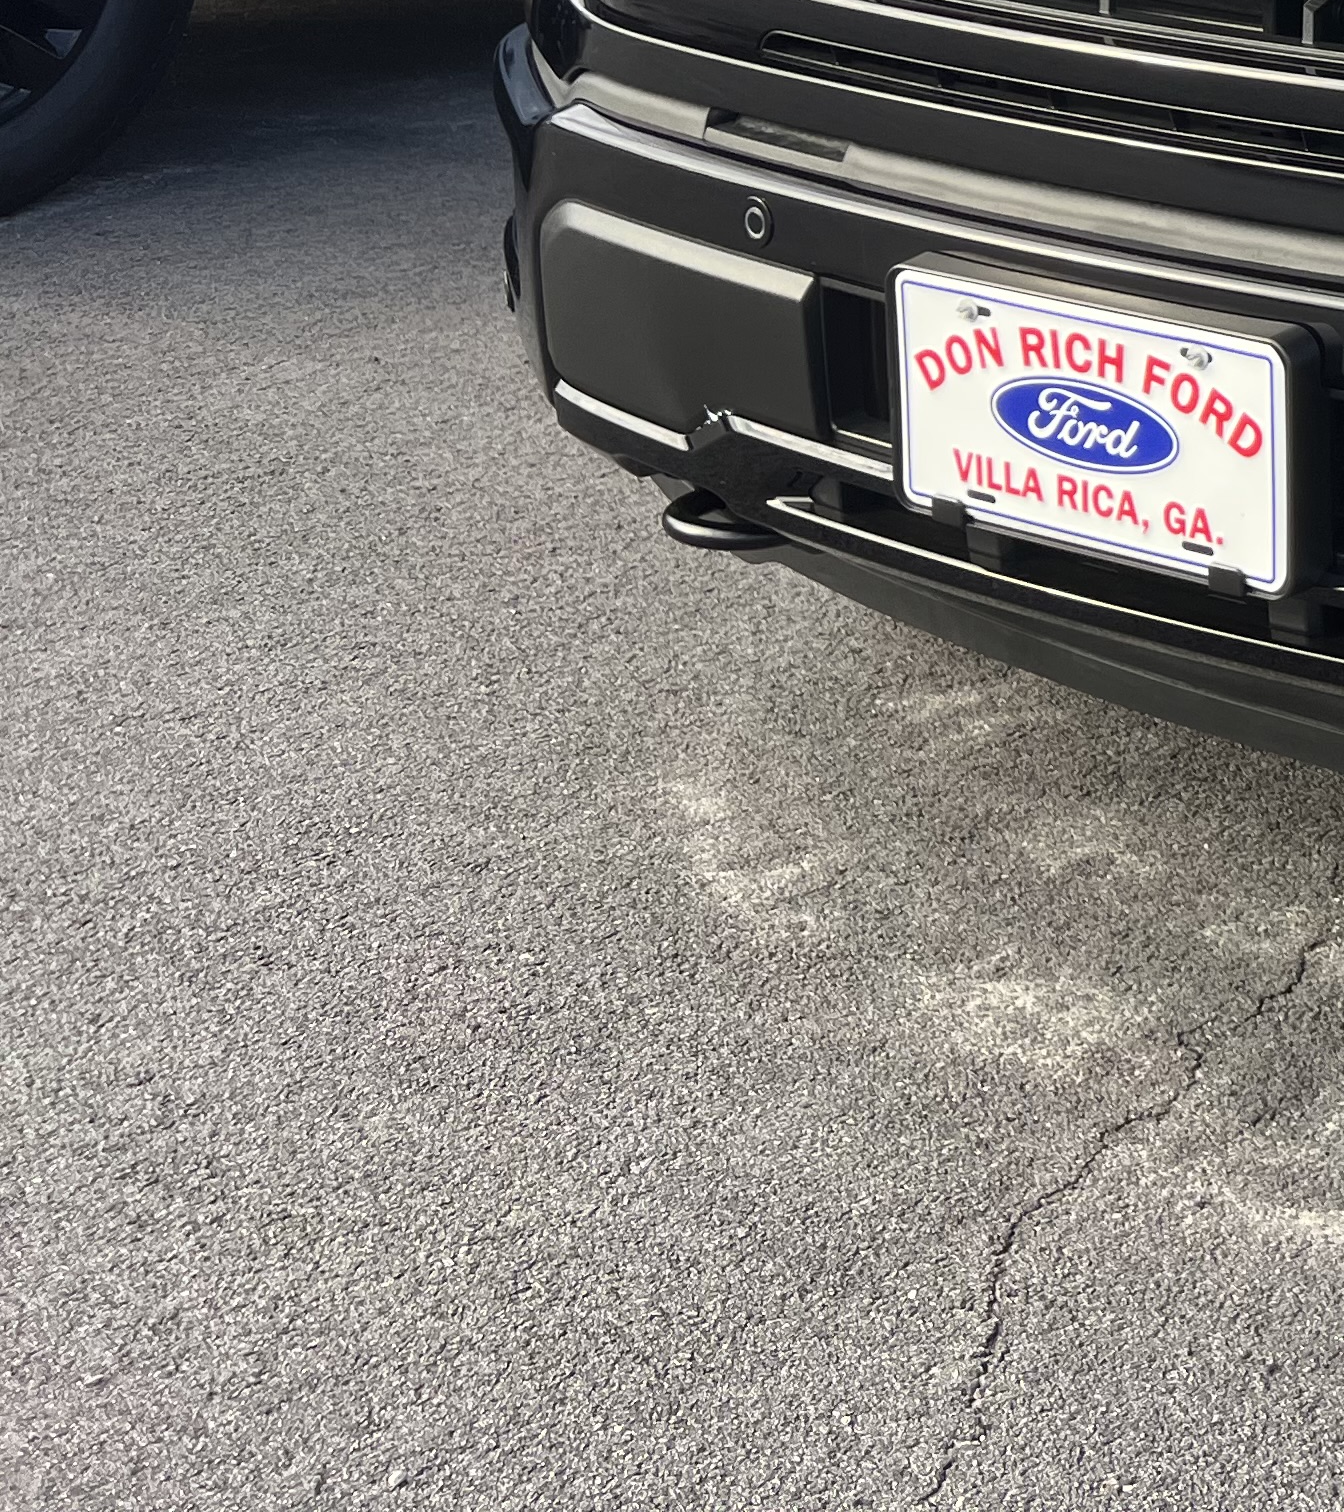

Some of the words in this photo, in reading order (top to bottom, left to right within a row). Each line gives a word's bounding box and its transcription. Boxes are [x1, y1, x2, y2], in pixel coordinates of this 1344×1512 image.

[914, 326, 1004, 390] DON
[1018, 326, 1125, 383] RICH
[1142, 354, 1264, 458] FORD
[1027, 387, 1141, 459] Ford
[952, 447, 1044, 502] VILLA
[1056, 473, 1150, 533] RICA,
[1163, 500, 1225, 546] GA.
